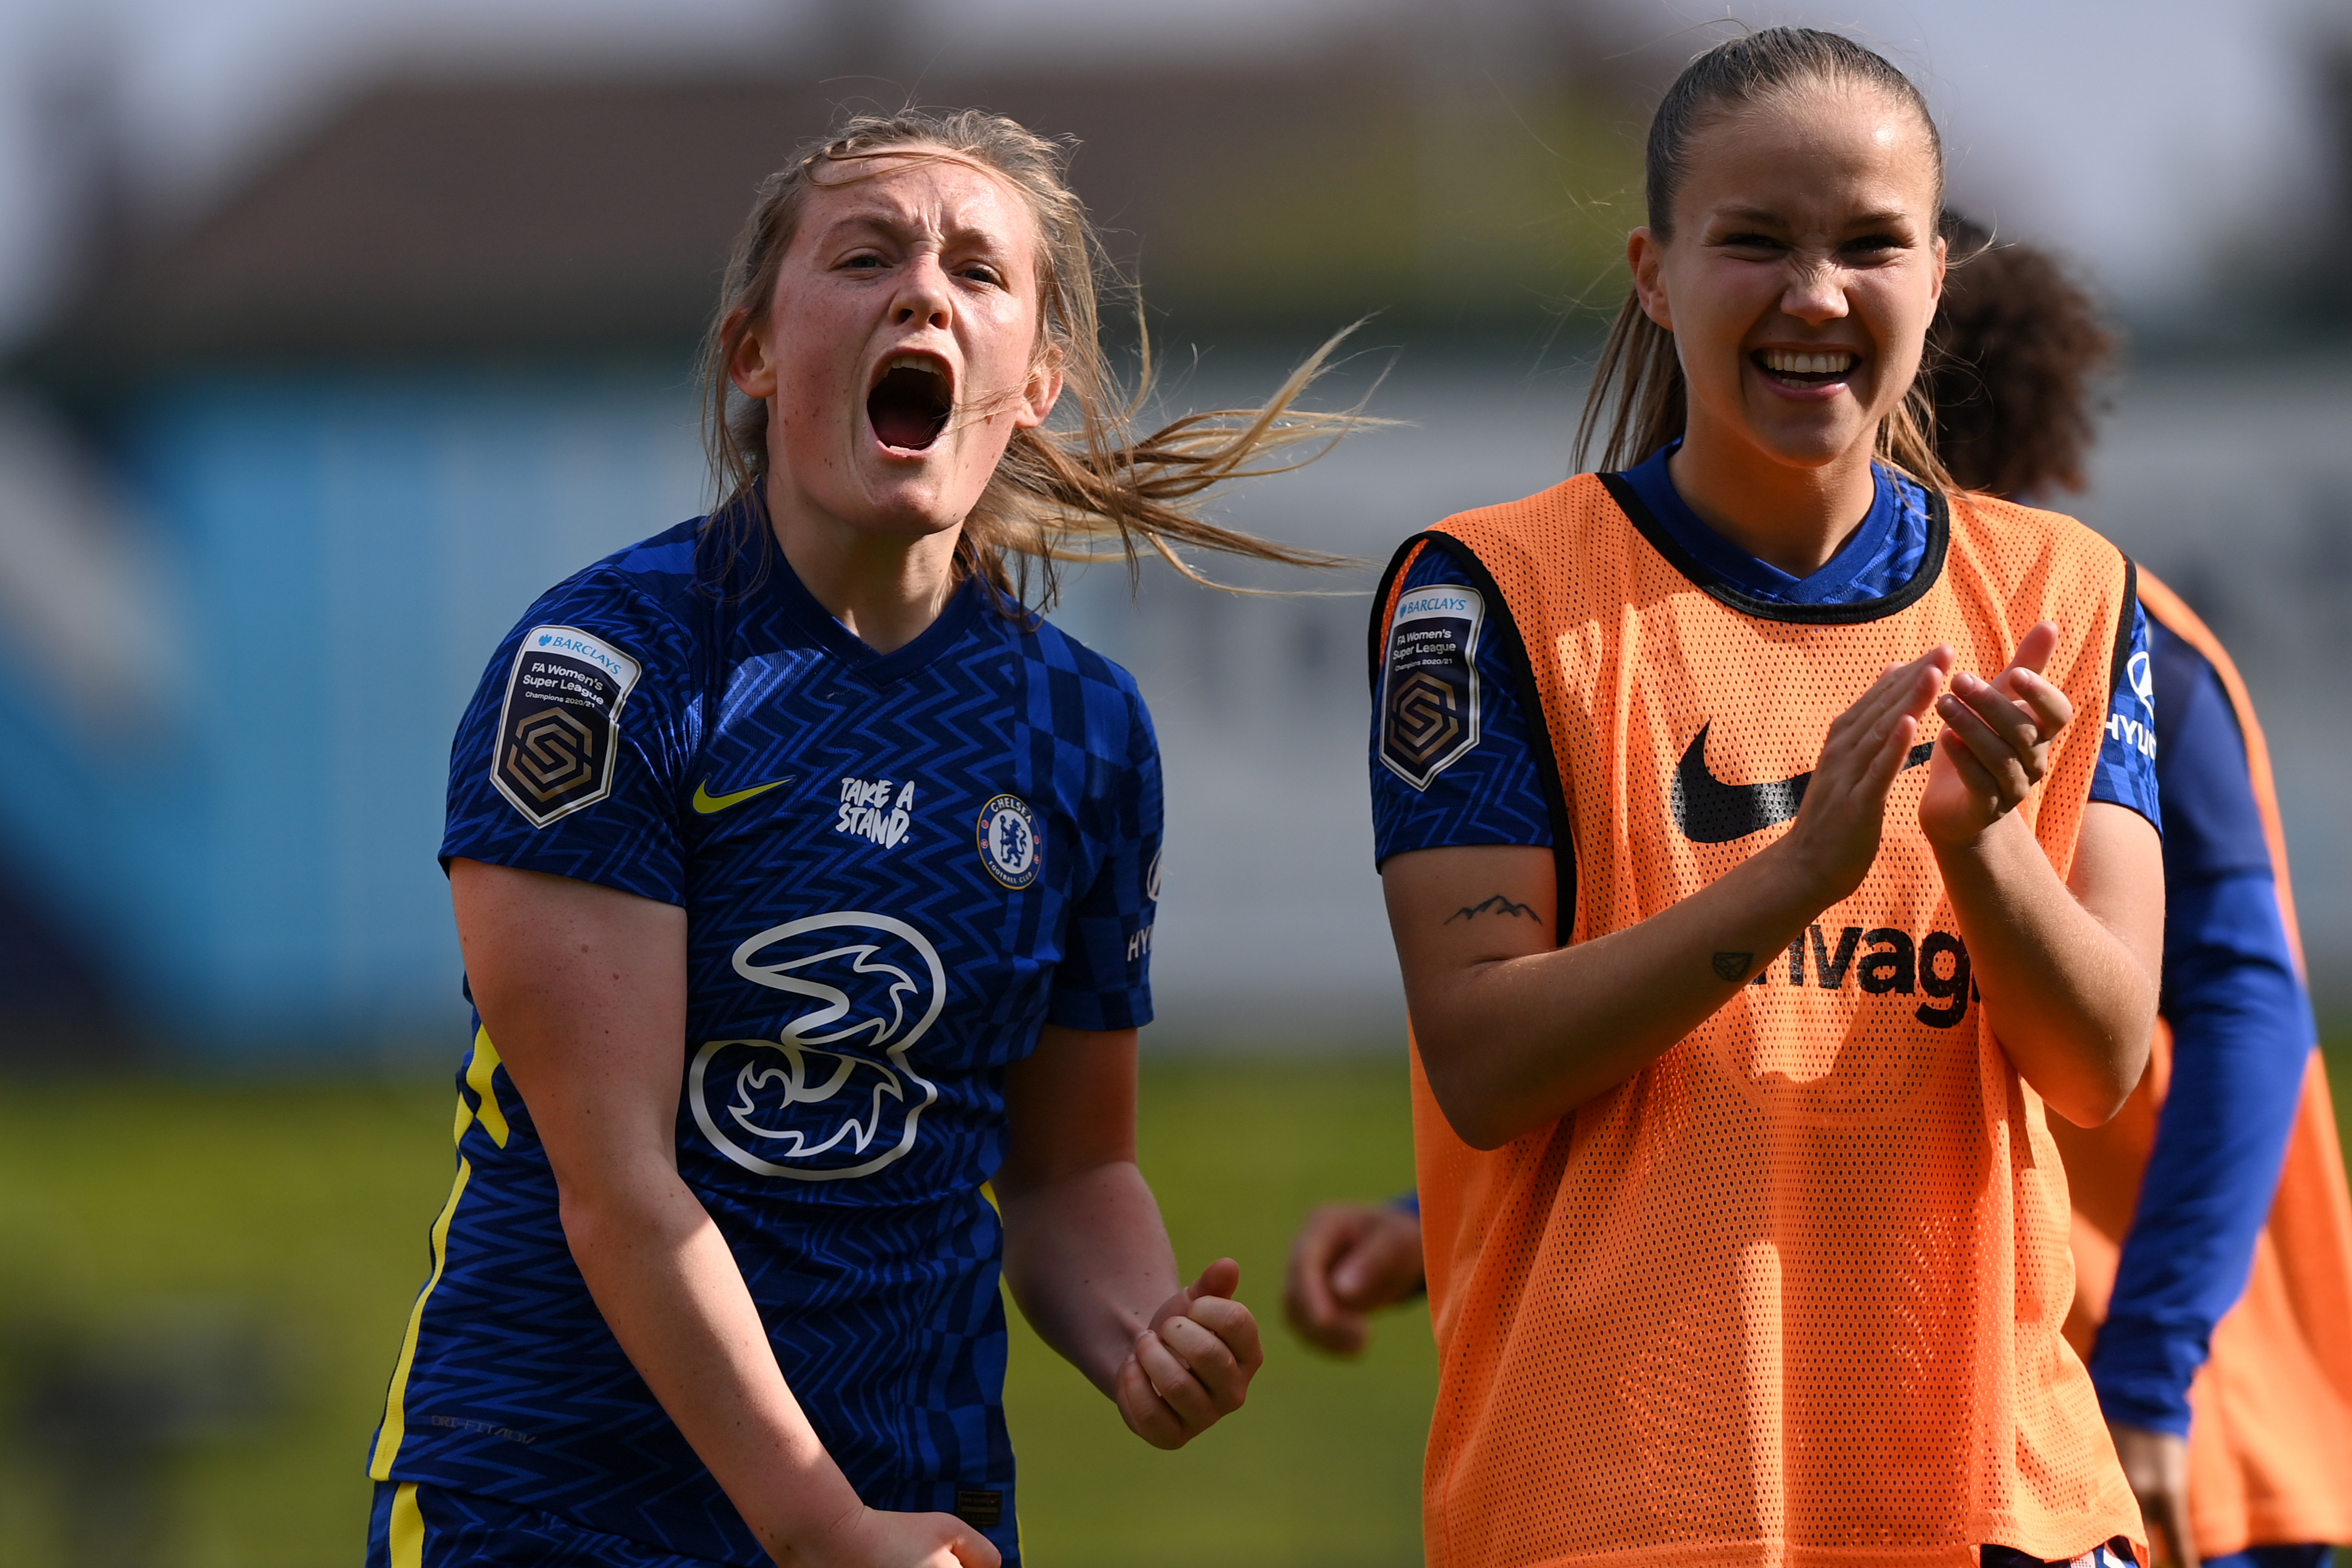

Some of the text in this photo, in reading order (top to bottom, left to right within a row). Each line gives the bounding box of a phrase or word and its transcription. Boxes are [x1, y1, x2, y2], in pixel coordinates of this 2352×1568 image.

[1407, 598, 1467, 614] BARCLAYS
[1397, 629, 1452, 646] FA Women's
[552, 636, 622, 675] BARCLAYS
[1393, 643, 1457, 660] Super League
[531, 662, 604, 691] FA Women's
[1394, 660, 1421, 672] Champions
[522, 674, 604, 705] Super League
[525, 691, 595, 708] Champions 2020/21
[840, 777, 915, 812] TAKE A
[990, 797, 1032, 824] CHELSEA
[835, 802, 910, 850] STAND.
[988, 860, 1033, 884] FOOTBALL CLUB
